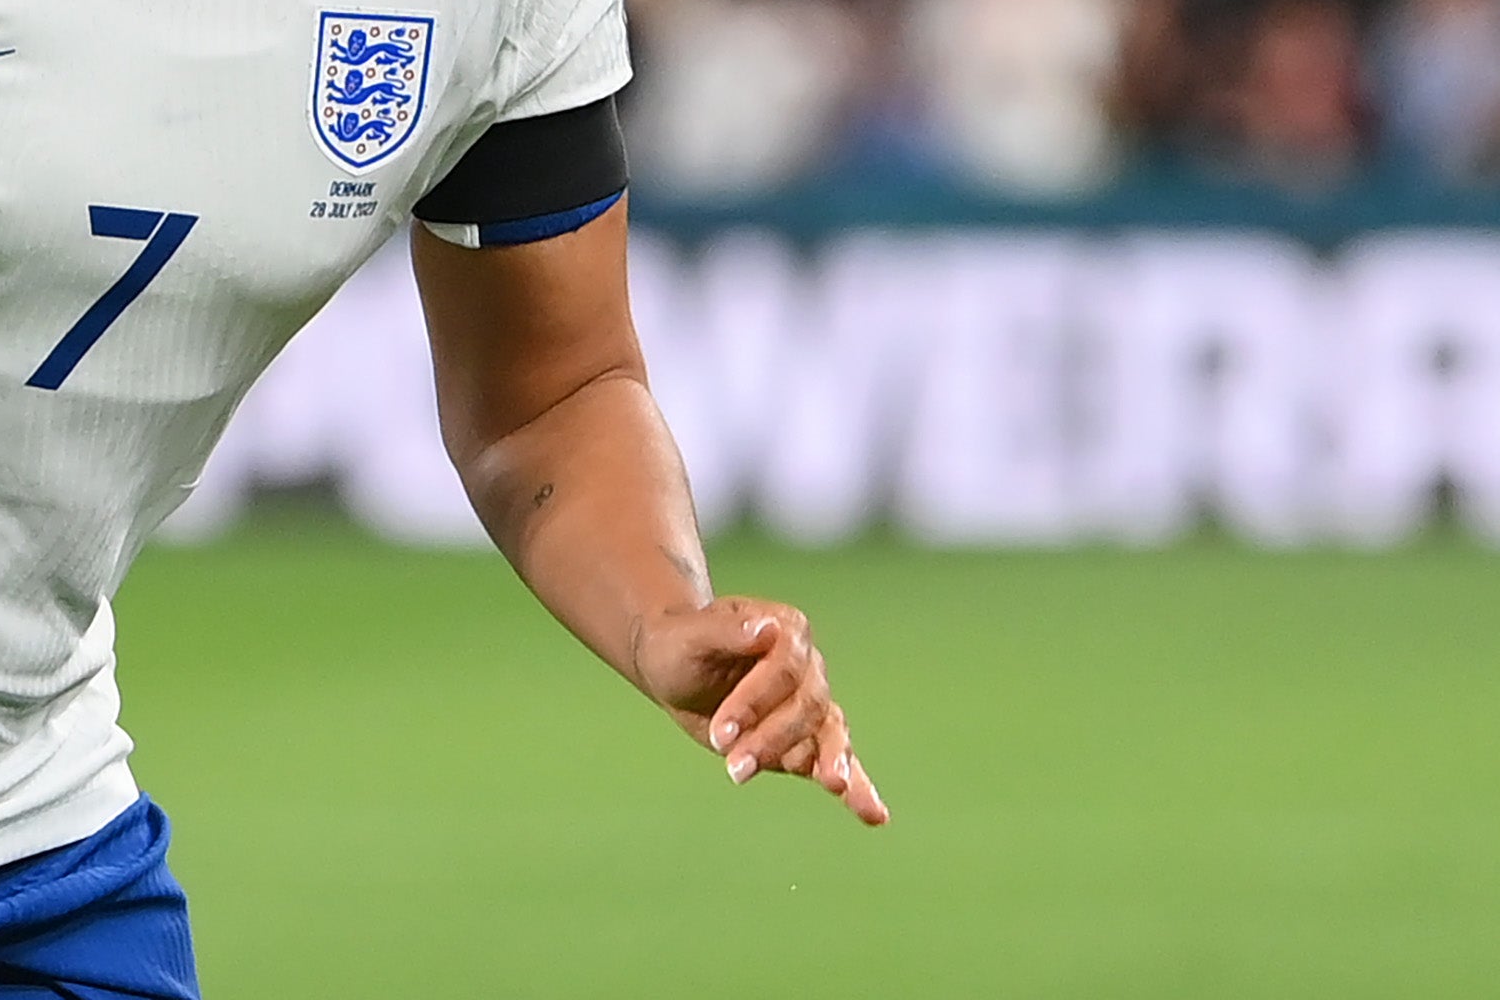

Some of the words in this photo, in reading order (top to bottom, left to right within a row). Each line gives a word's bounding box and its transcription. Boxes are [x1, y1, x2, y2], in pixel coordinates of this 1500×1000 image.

[329, 181, 377, 197] DENMARK
[309, 201, 327, 218] 28
[328, 202, 353, 219] JULY
[23, 204, 200, 391] 7
